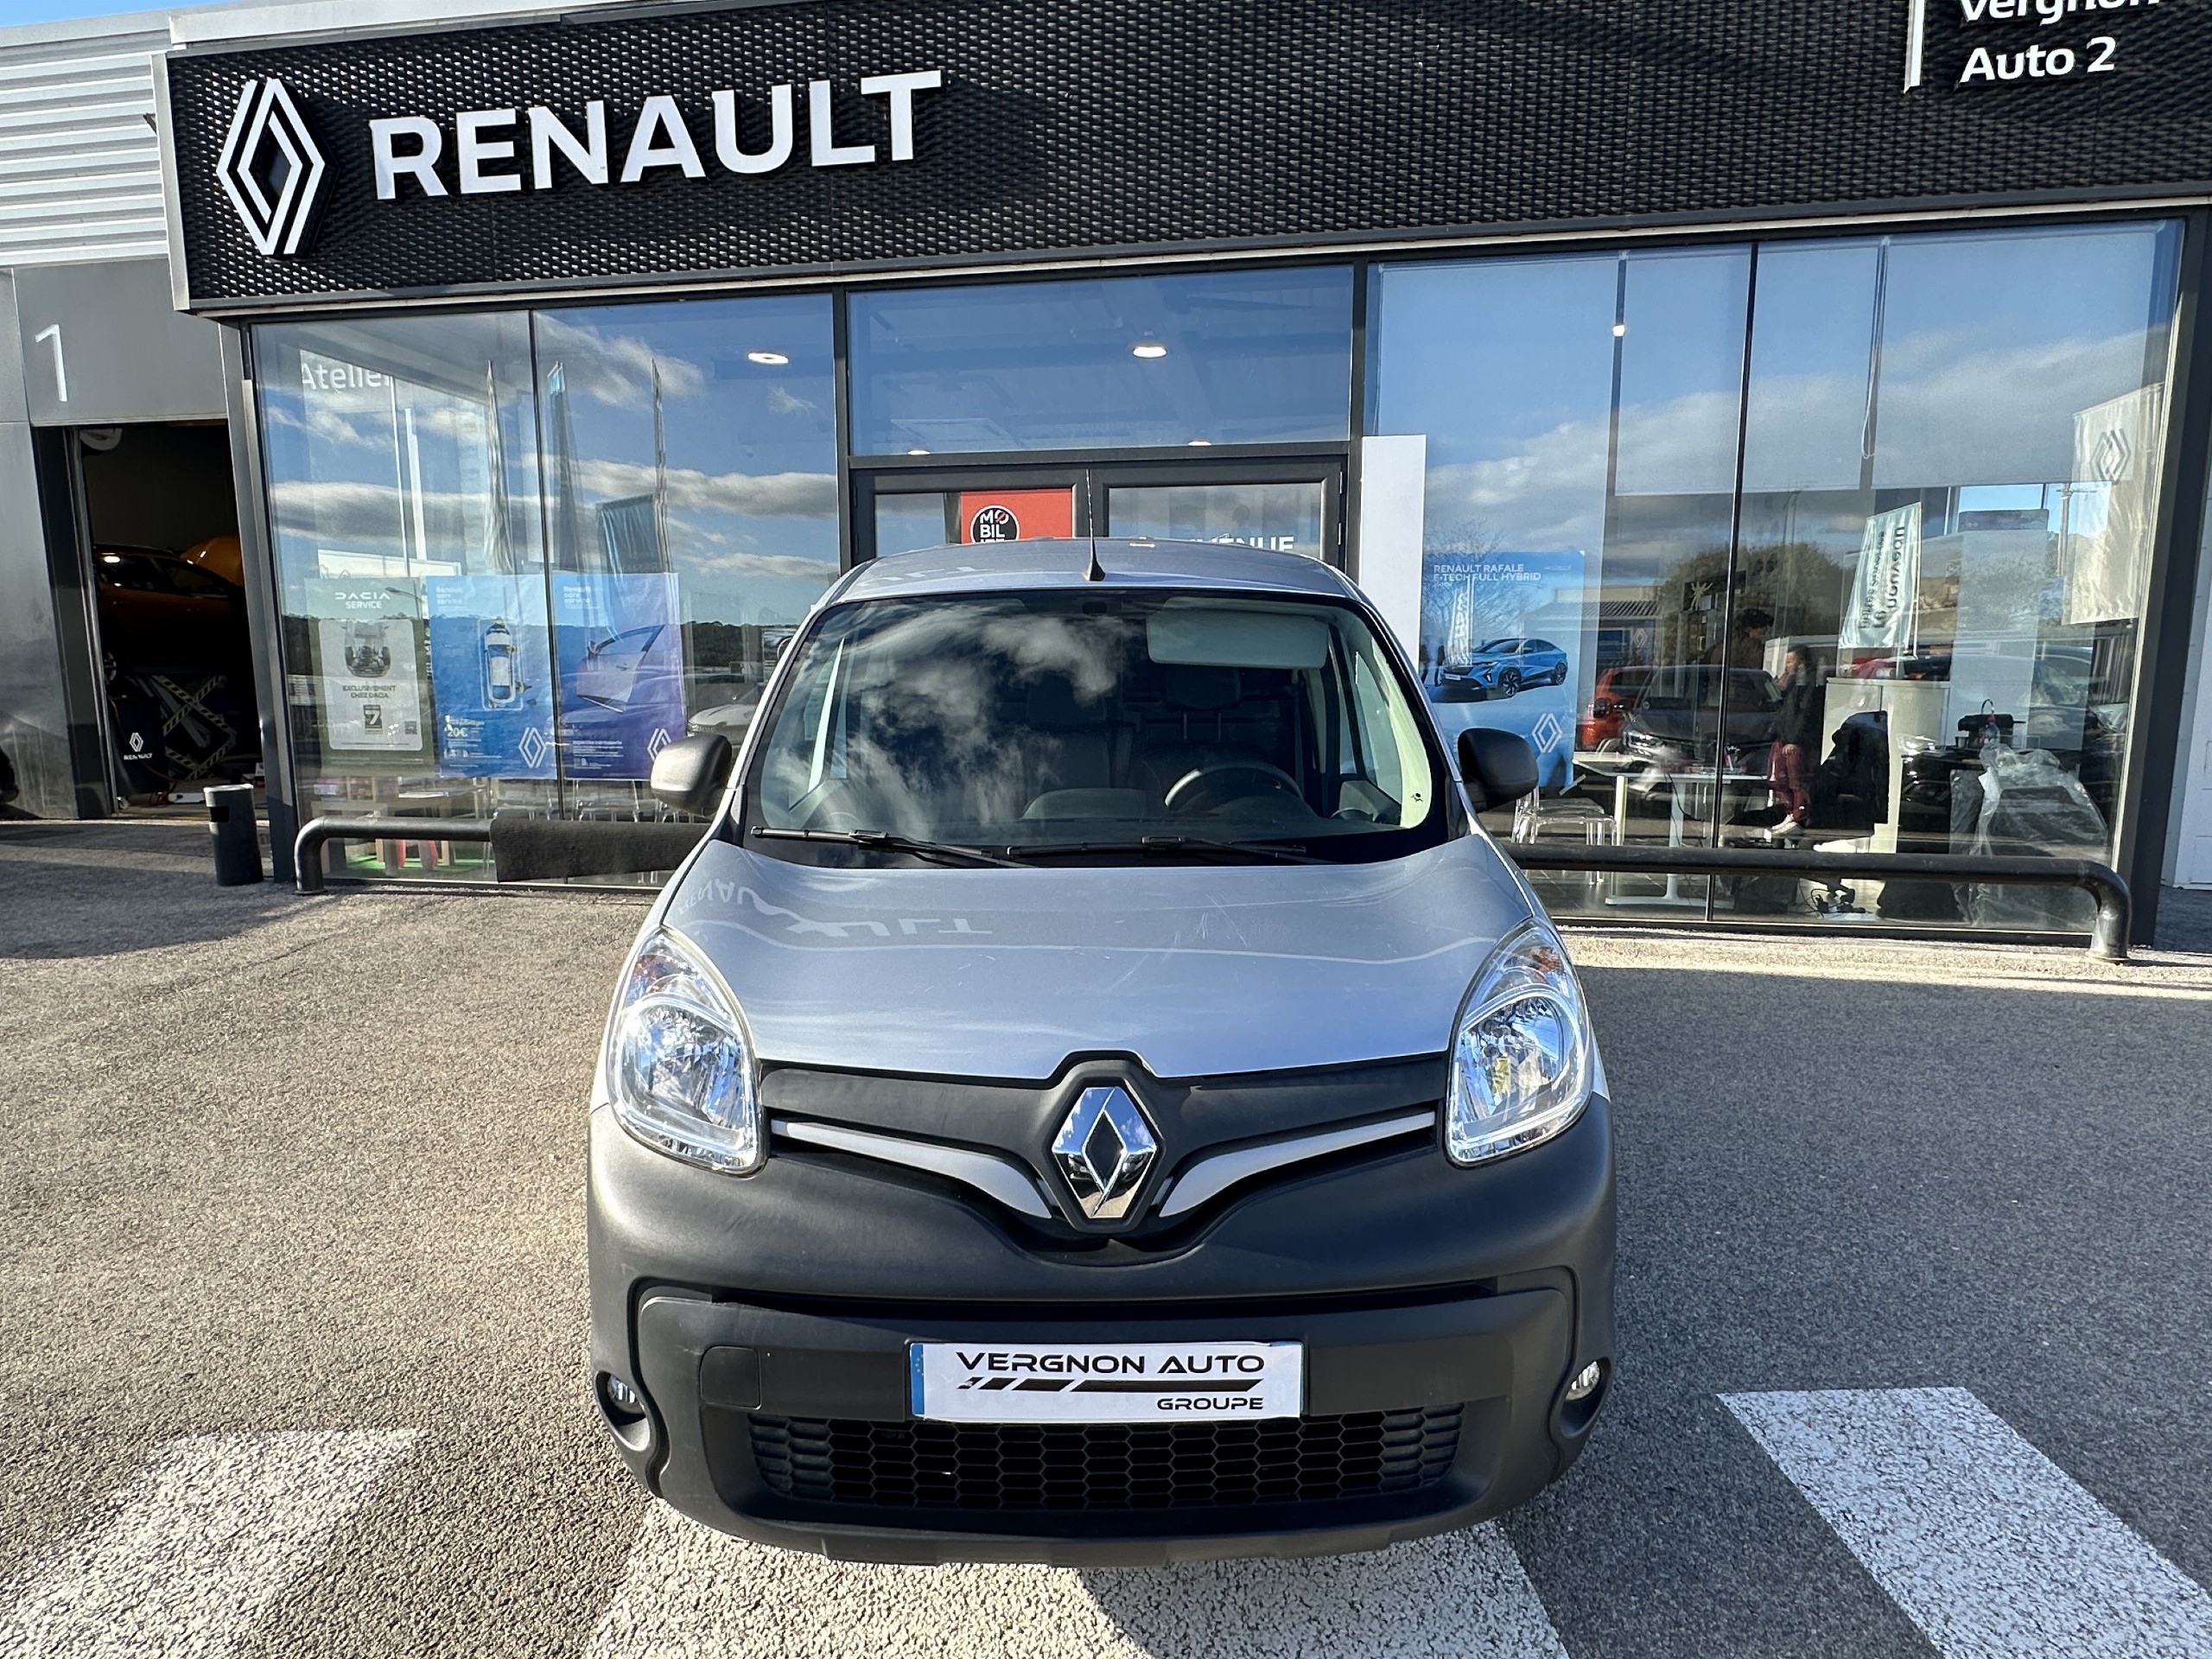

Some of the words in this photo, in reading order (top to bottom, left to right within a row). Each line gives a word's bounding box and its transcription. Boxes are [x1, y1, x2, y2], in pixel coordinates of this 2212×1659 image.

[1960, 0, 2159, 26] Verg
[1960, 44, 2075, 83] Auto
[2086, 36, 2116, 73] 2
[369, 70, 942, 200] RENAULT
[35, 324, 68, 402] 1
[980, 524, 1005, 537] BIL
[1433, 564, 1481, 573] RENAULT
[1484, 563, 1524, 573] RAFALE
[1472, 573, 1499, 582] FULL
[1502, 572, 1541, 582] HYBRID
[346, 601, 382, 609] SERVICE
[365, 709, 381, 726] 7
[956, 1351, 1145, 1375] VERGNON
[1157, 1354, 1265, 1375] AUTO
[1157, 1397, 1264, 1411] GROUPE
